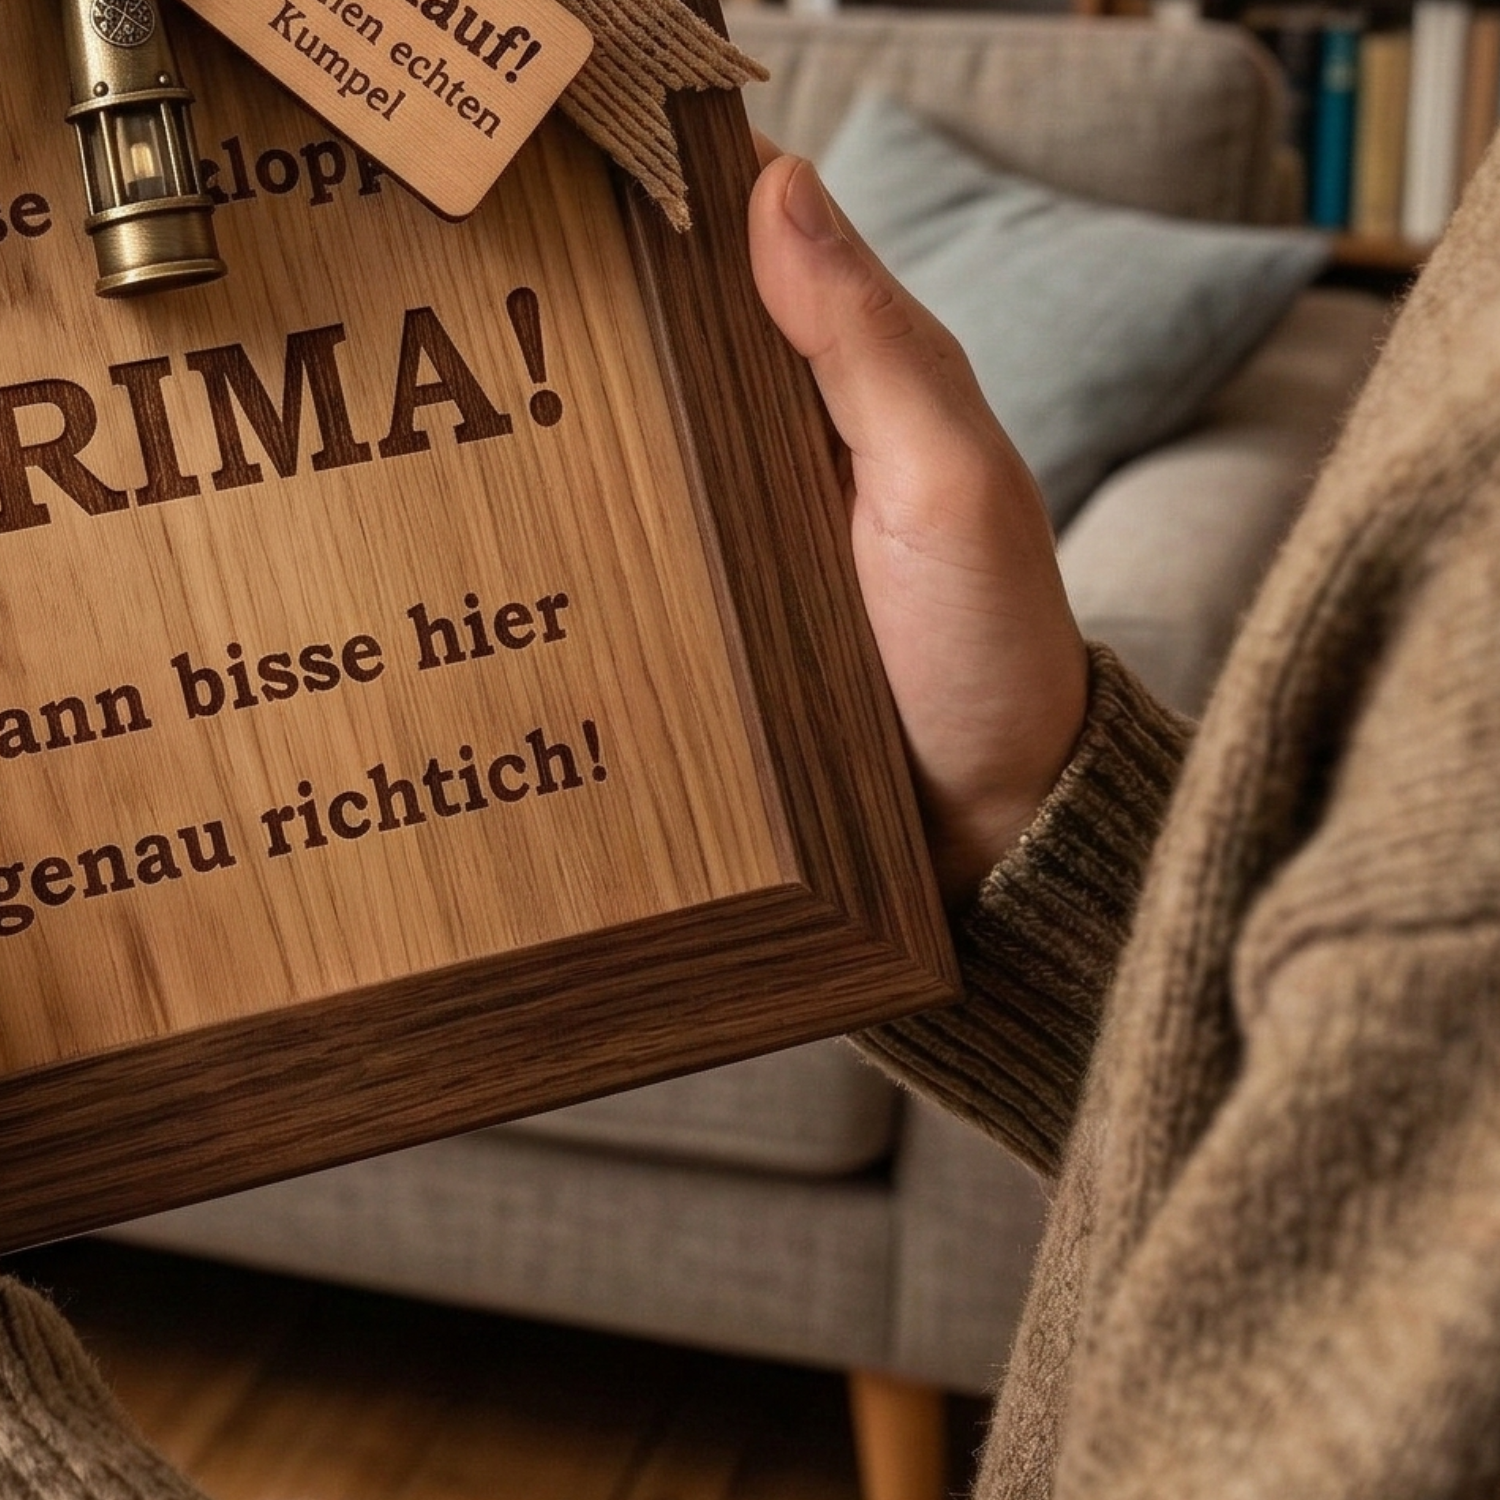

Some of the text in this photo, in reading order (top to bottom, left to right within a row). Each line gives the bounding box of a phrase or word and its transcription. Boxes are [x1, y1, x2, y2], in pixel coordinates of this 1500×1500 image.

[389, 41, 501, 139] echten
[170, 634, 385, 720] bisse
[406, 592, 570, 671] hier
[260, 719, 608, 858] richtich!
